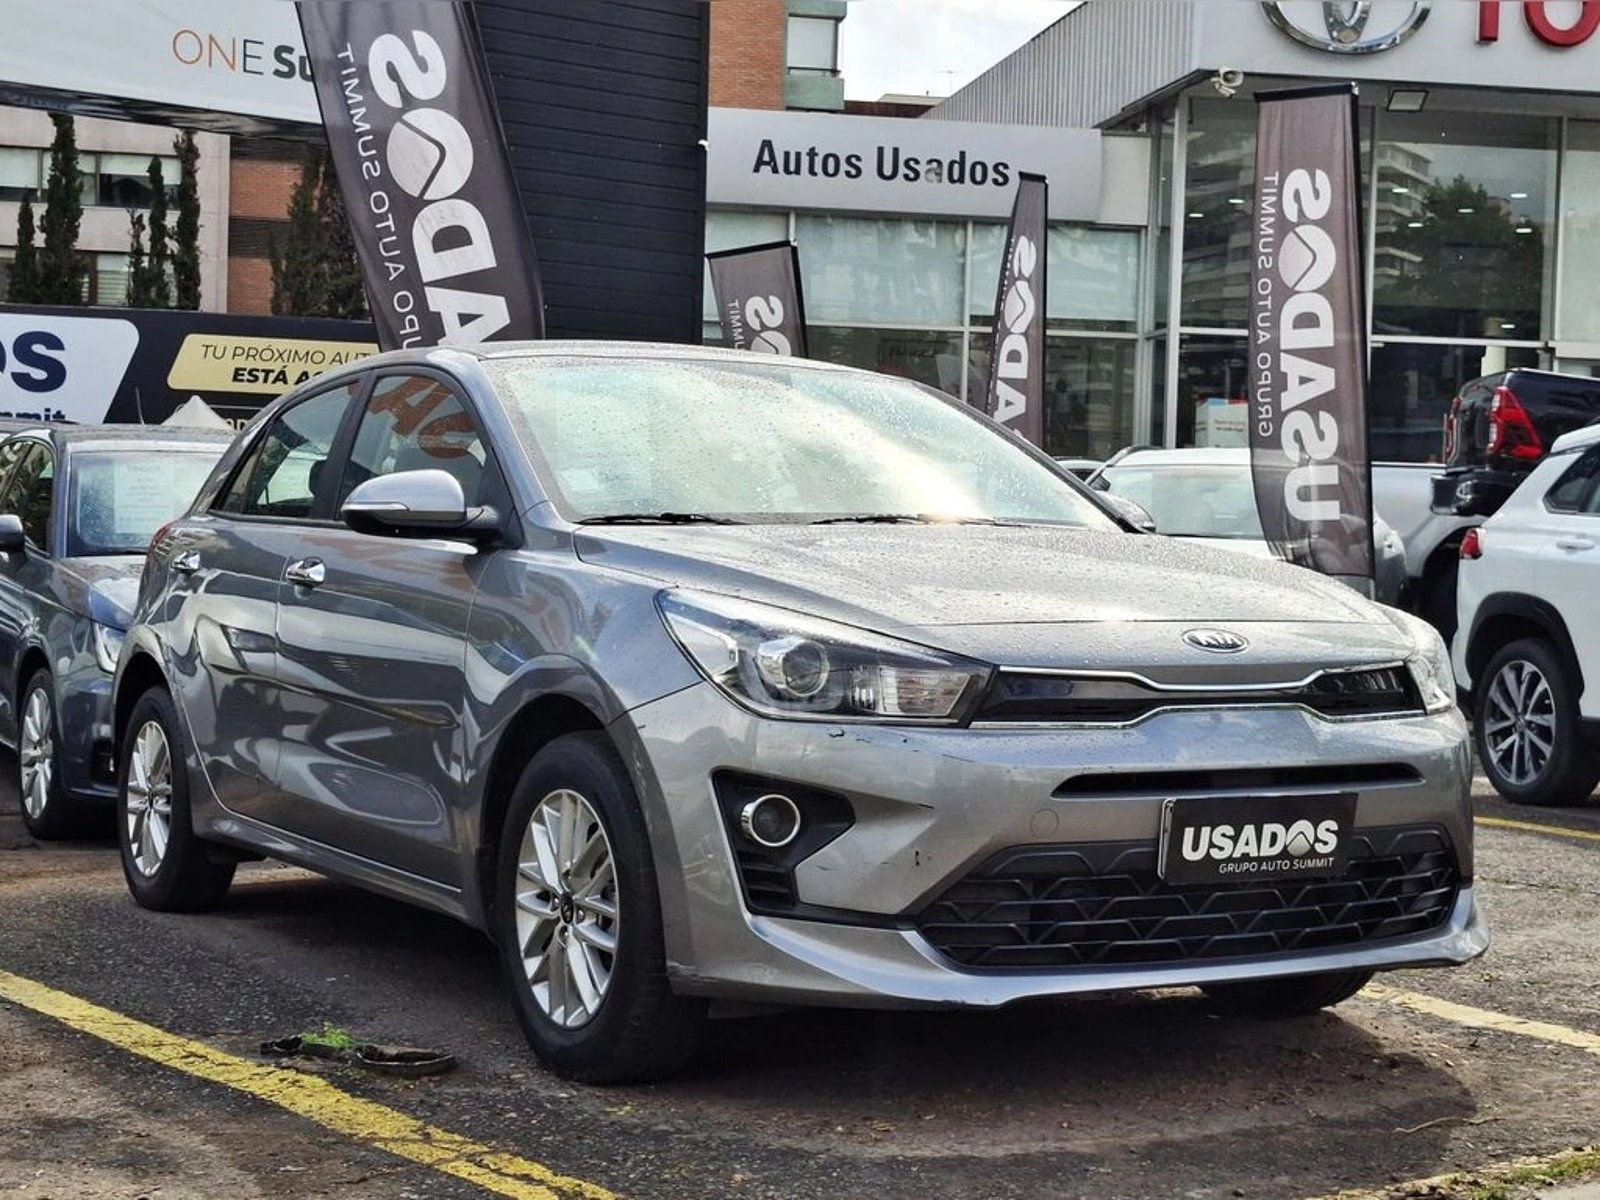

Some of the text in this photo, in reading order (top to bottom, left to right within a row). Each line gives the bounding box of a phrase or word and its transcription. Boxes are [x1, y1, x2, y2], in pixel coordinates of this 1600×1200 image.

[172, 29, 265, 76] ONE
[752, 139, 1010, 187] Autos Usados
[201, 344, 228, 360] TU
[231, 344, 326, 365] PRÓXIMO
[231, 365, 289, 385] ESTÁ
[1182, 819, 1339, 862] USADOS
[1219, 857, 1335, 874] GRUPO AUTO SUMMIT
